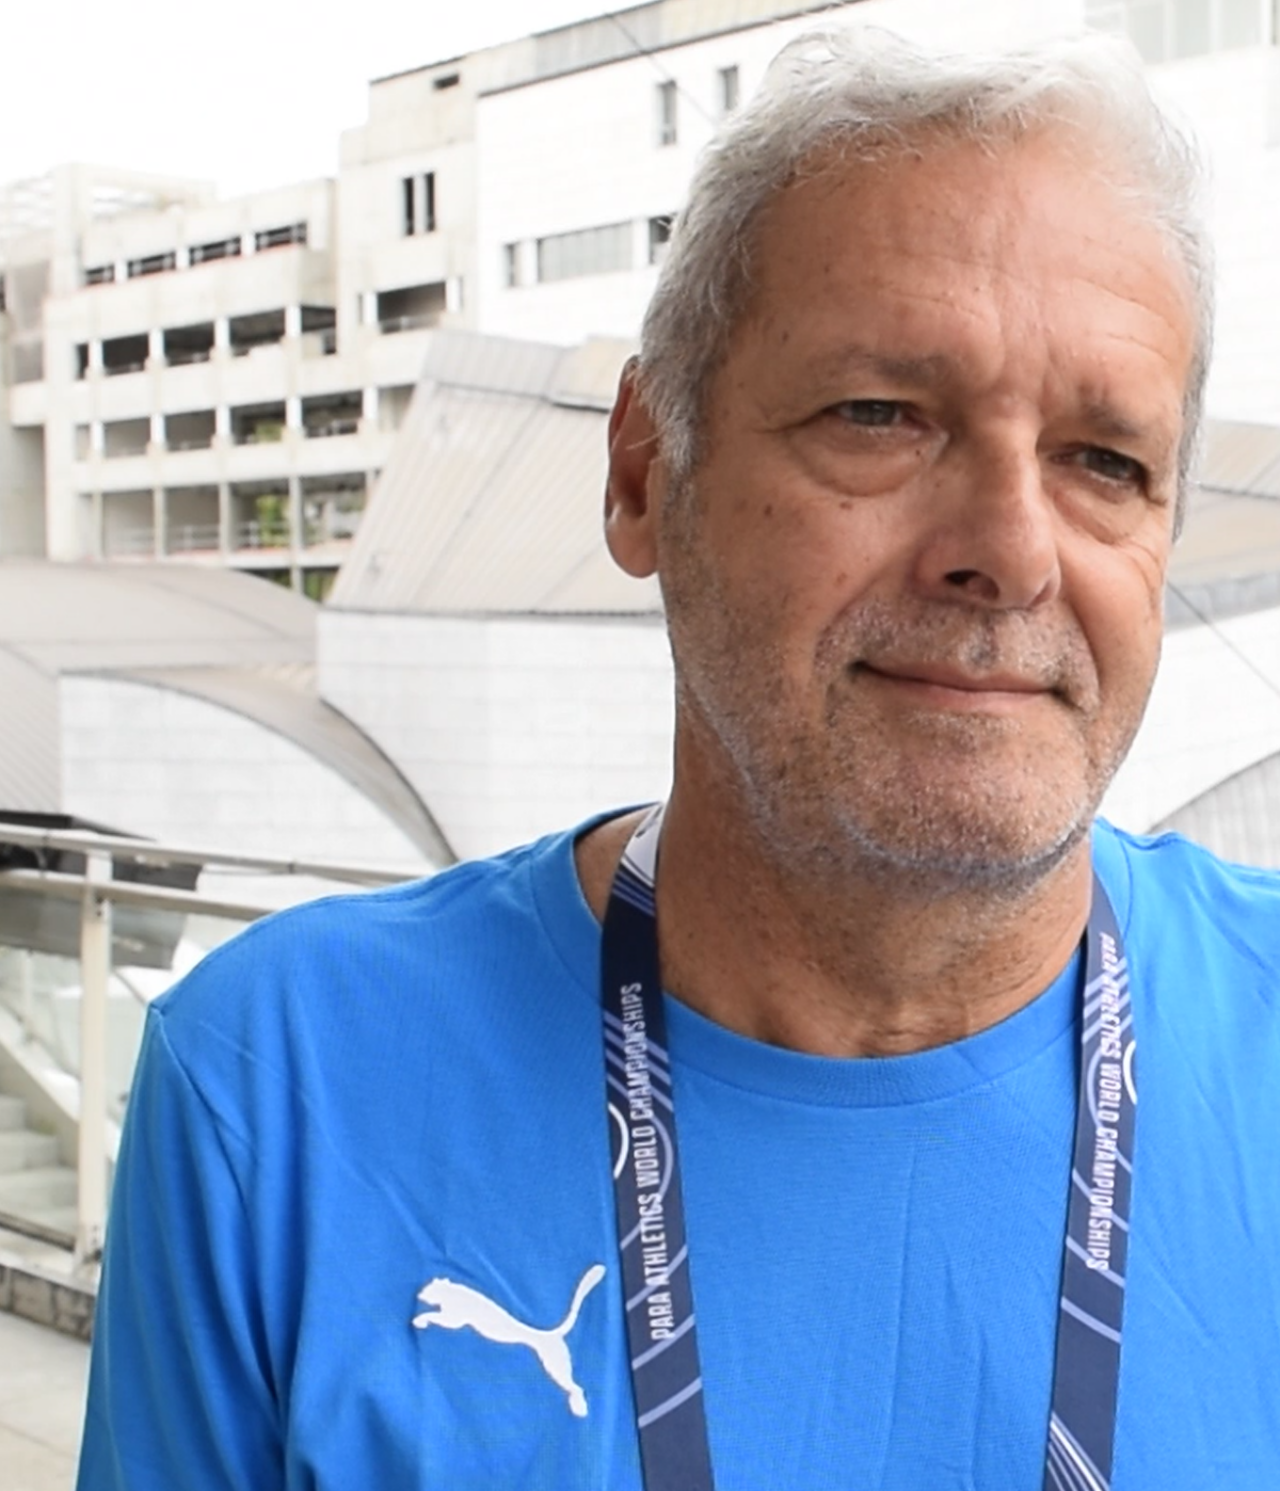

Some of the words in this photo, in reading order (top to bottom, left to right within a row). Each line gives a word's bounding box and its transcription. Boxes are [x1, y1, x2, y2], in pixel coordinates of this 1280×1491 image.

[620, 982, 654, 1121] CHAMPIONSHIPS
[1097, 1062, 1122, 1122] WORLD
[632, 1125, 660, 1188] WORLD
[1086, 1126, 1119, 1272] CHAMPIONSHIPS
[639, 1193, 670, 1286] ATHLETICS
[648, 1292, 675, 1340] PARA
